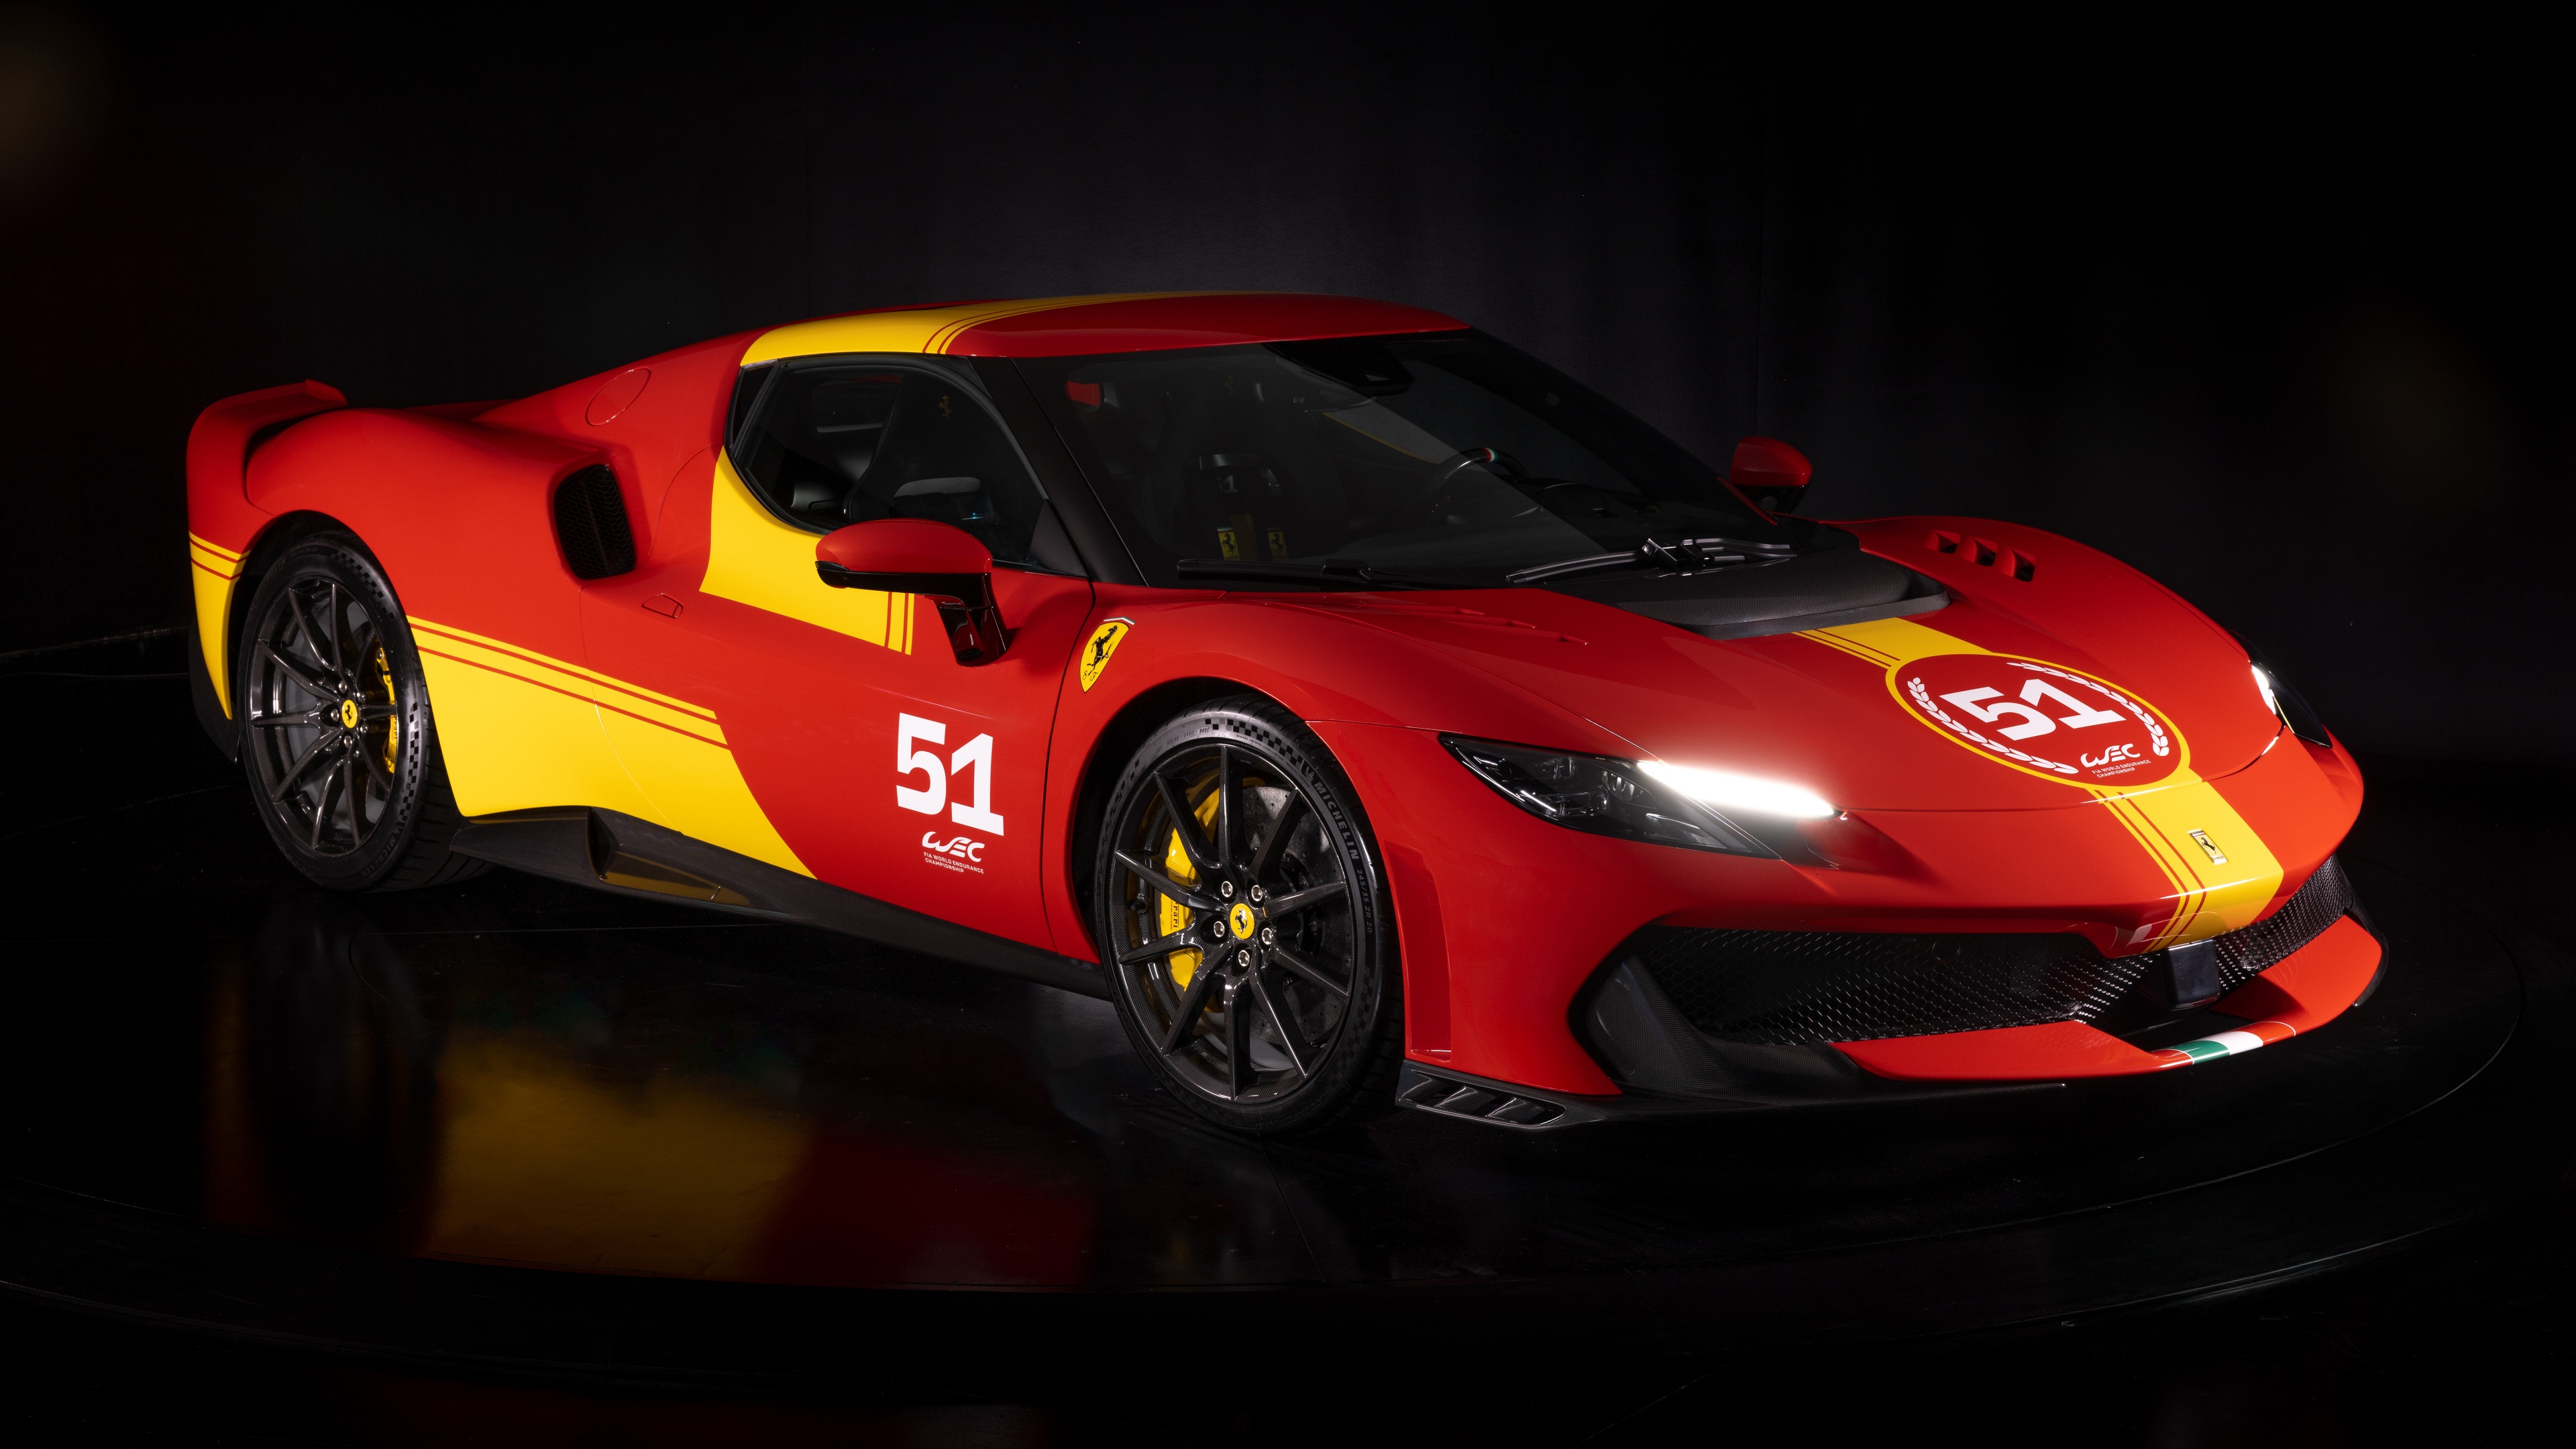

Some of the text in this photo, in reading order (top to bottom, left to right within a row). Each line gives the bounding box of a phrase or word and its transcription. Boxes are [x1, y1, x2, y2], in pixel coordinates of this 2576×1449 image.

[1938, 678, 2127, 741] 51
[2080, 743, 2141, 767] WEC
[2120, 759, 2151, 769] ENDURANCE
[896, 712, 1004, 836] 51
[2096, 767, 2135, 778] CHAMPIONSHIP
[922, 831, 985, 863] WEC
[1313, 782, 1373, 933] MICHELIN 245/35 ZR 20
[925, 857, 964, 873] CHAMPIONSHIP
[932, 854, 952, 864] WORLD
[953, 860, 984, 874] ENDURANCE
